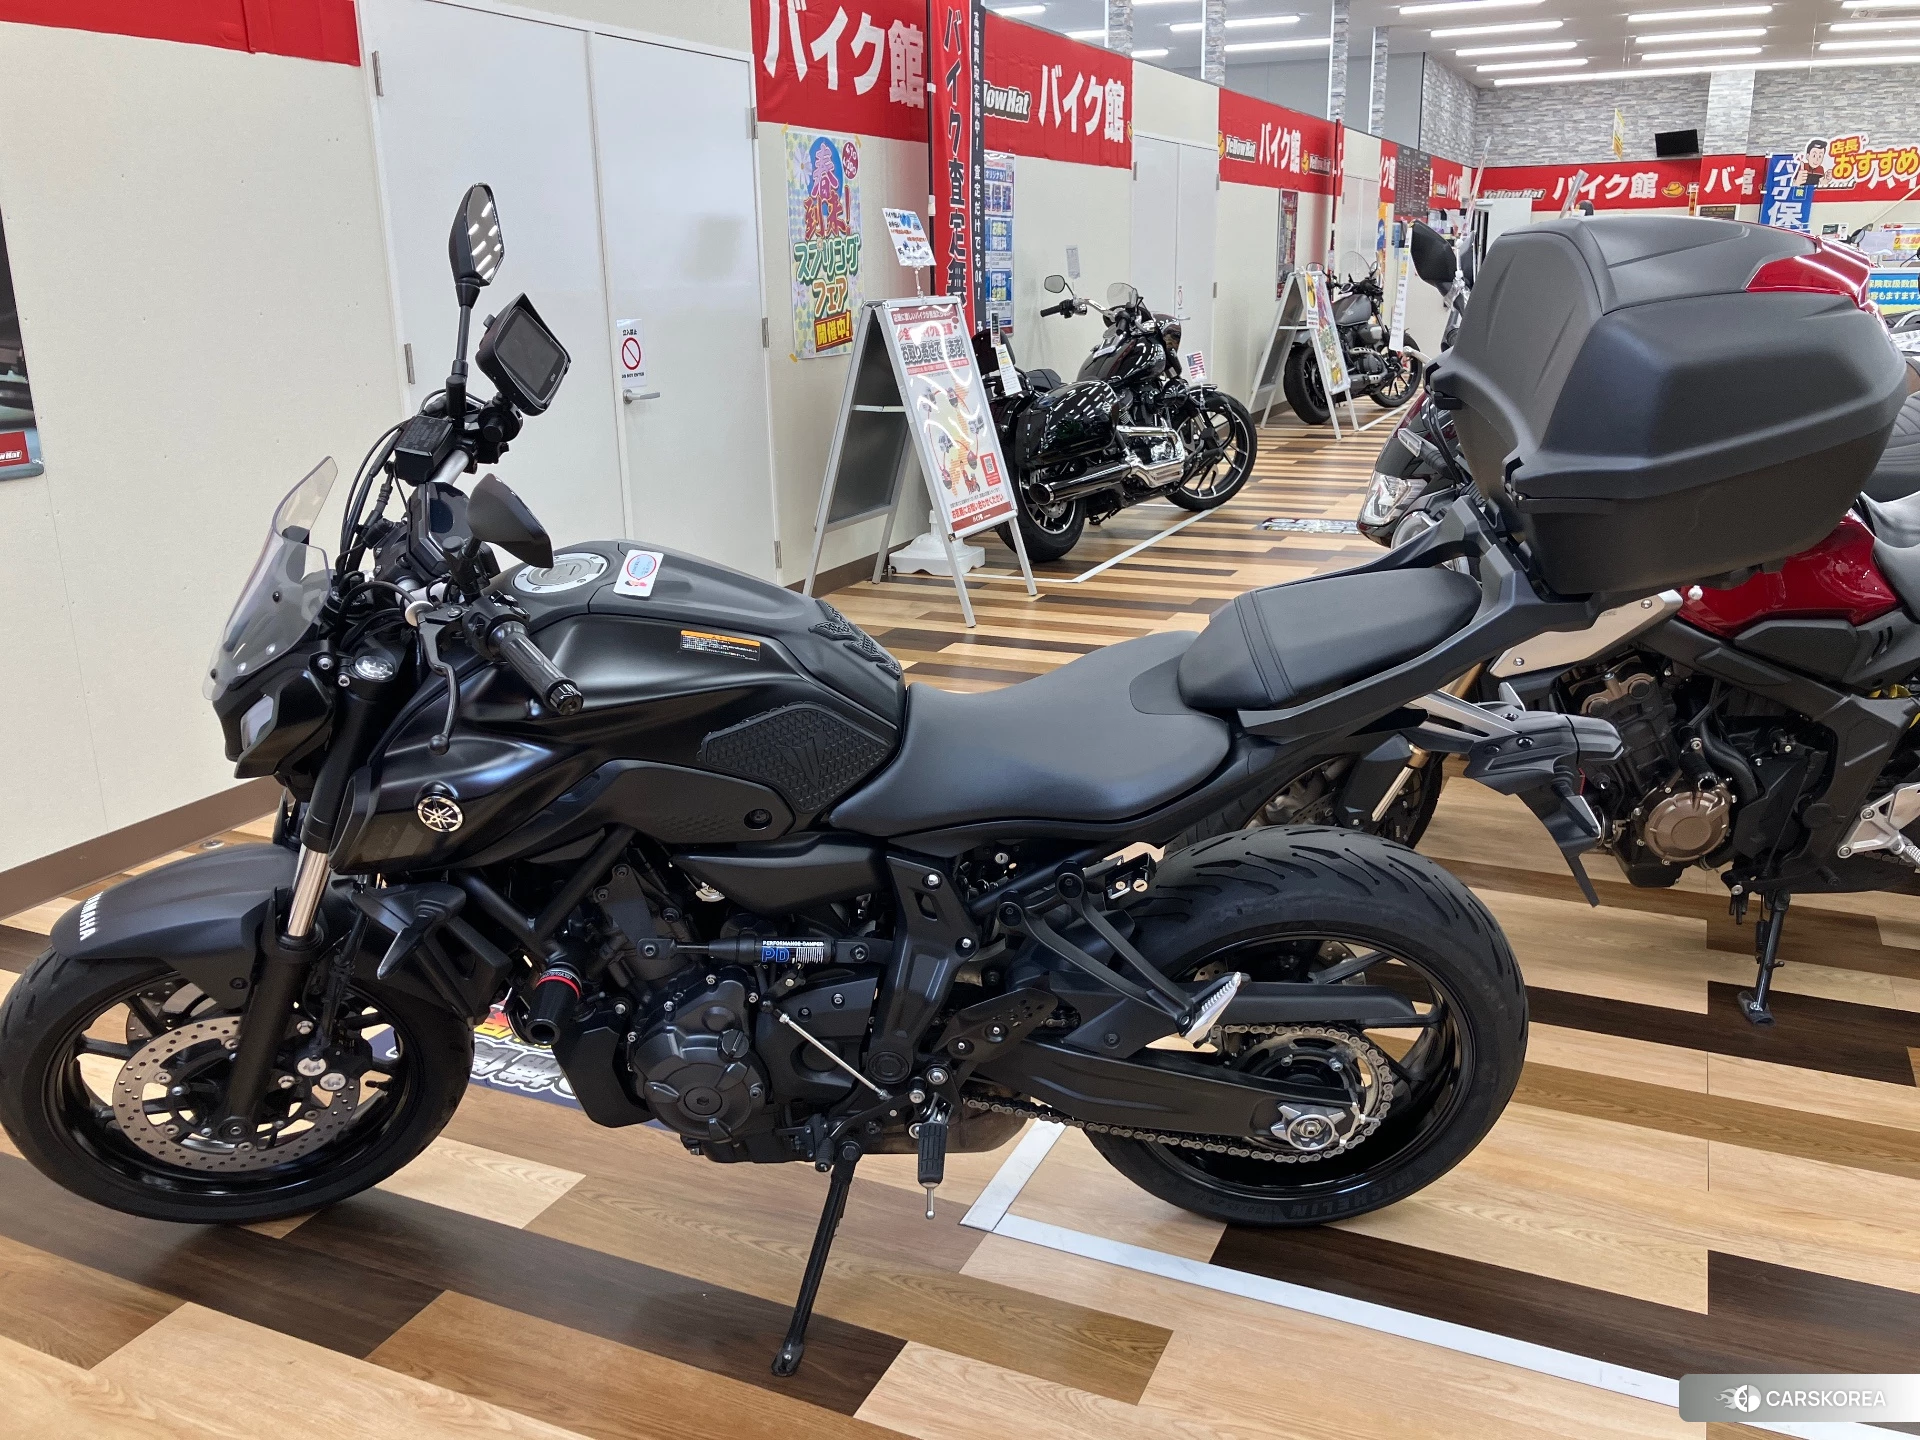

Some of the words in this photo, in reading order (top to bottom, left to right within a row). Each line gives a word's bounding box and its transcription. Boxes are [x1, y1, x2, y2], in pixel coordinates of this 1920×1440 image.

[763, 0, 925, 109] バイク館
[1038, 64, 1125, 144] バイク館
[1259, 122, 1301, 174] バイク館
[1831, 136, 1860, 154] 店長
[1832, 147, 1920, 179] おすすめ
[811, 143, 839, 200] 春
[1552, 172, 1659, 200] バイク館
[794, 234, 861, 281] スプリング
[813, 275, 848, 318] フェア
[816, 311, 850, 346] 開催中!
[761, 946, 790, 963] PD
[1289, 1171, 1415, 1218] MICHELIN
